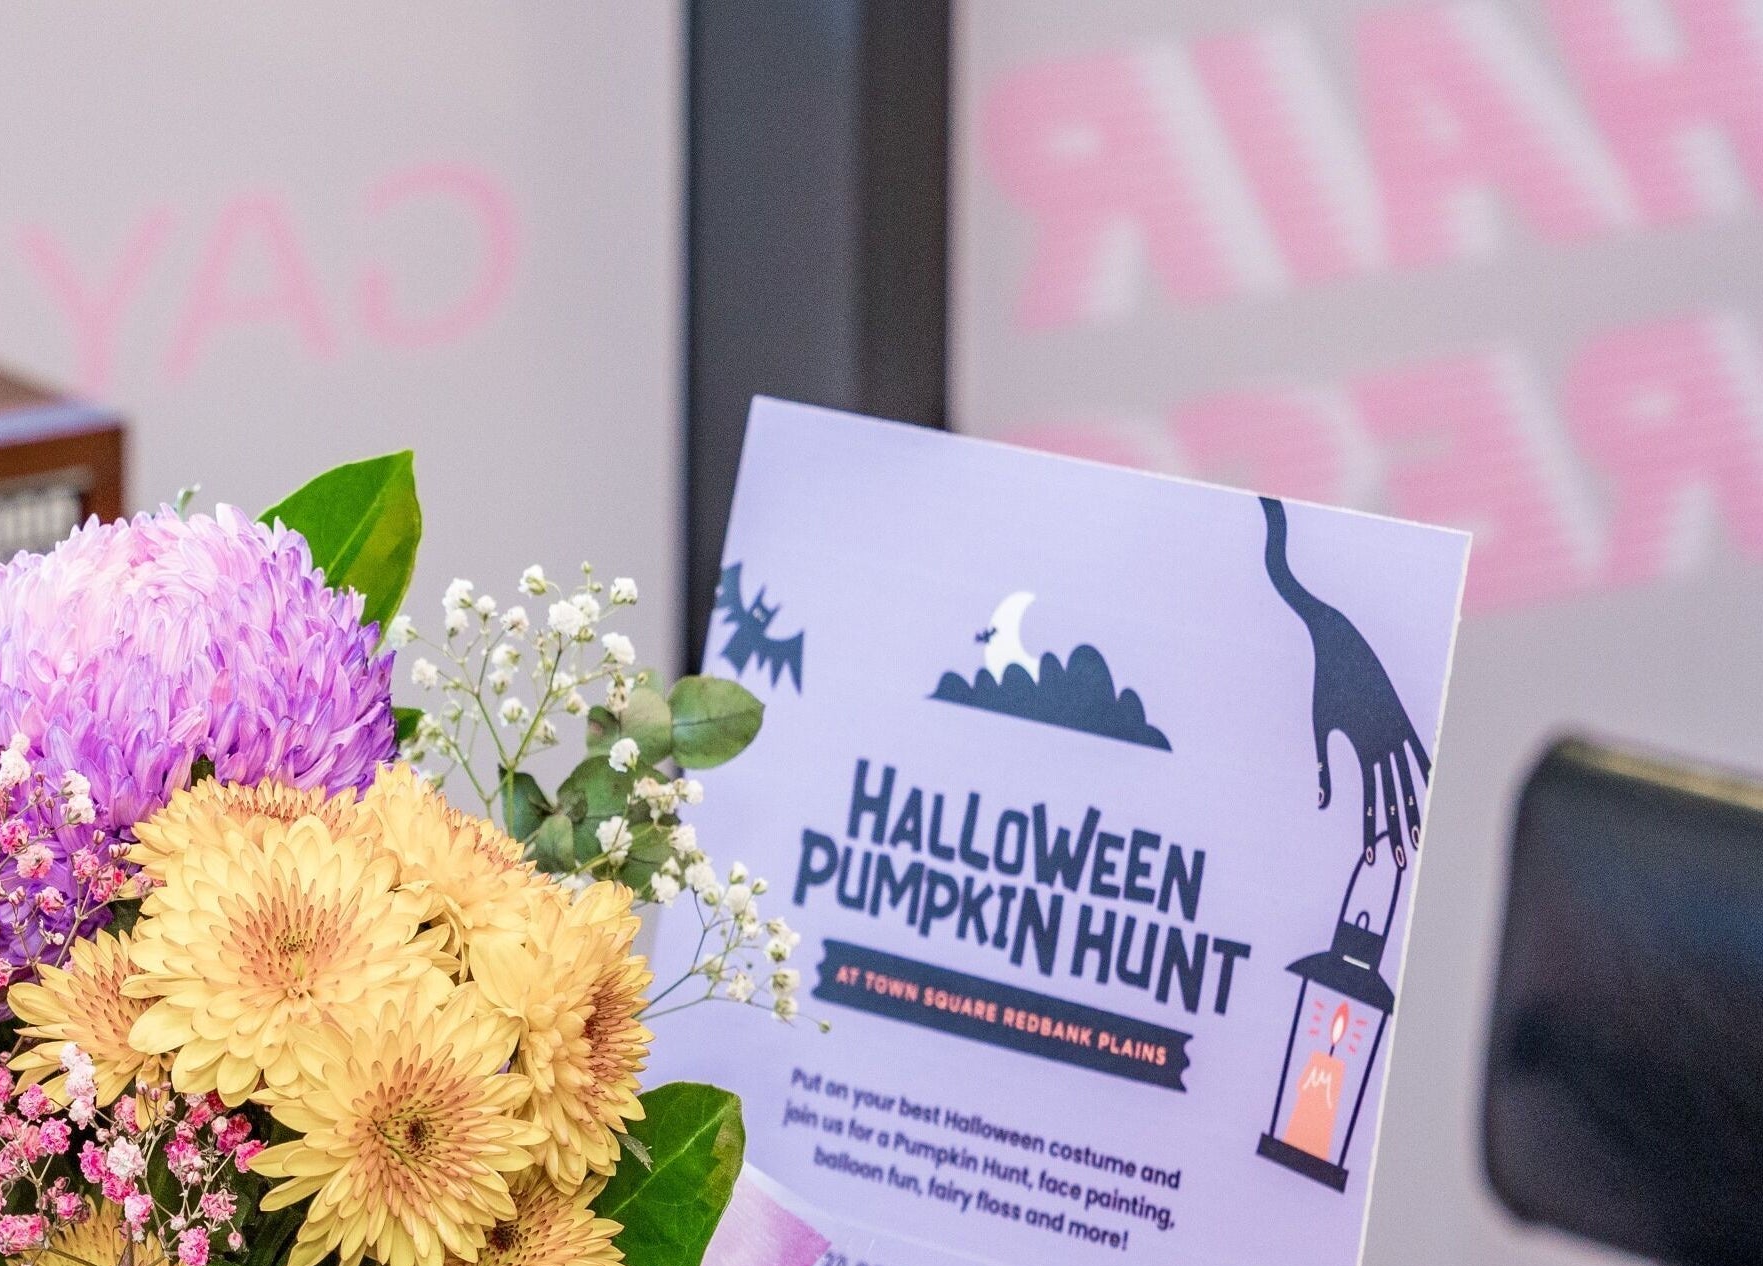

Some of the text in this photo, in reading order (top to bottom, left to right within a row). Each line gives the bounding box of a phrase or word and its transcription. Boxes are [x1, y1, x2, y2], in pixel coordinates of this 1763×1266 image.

[847, 758, 1206, 922] HALLOWEEN
[792, 828, 1252, 1015] PUMPKIN HUNT
[836, 965, 1167, 1066] AT TOWN SQUARE REDBANK PLAINS
[783, 1100, 1176, 1231] join us for a Pumpkin Hunt, face painting,
[792, 1067, 1181, 1190] Put on your best Halloween costume and
[814, 1145, 1129, 1251] balloon fun, fairy floss and more!
